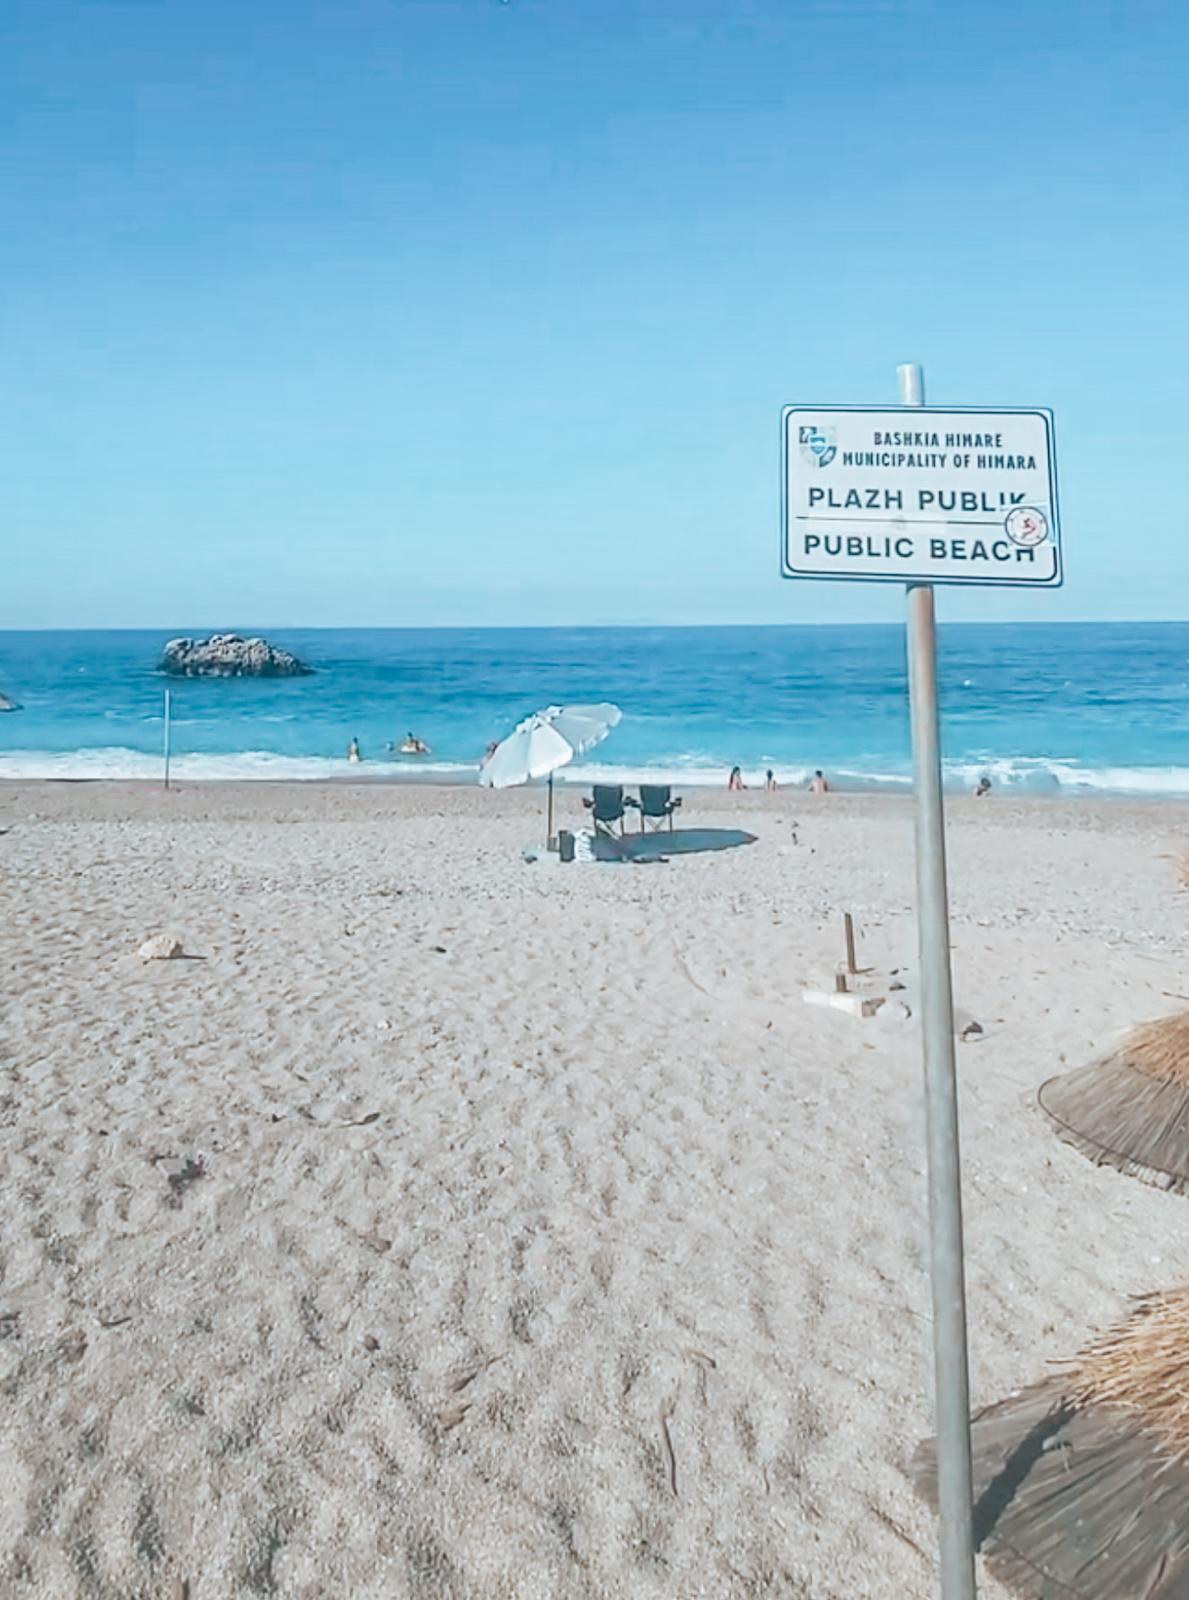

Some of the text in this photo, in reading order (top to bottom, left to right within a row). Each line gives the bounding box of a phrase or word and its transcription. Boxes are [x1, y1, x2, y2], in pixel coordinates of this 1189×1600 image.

[874, 432, 939, 446] BASHKIA
[843, 452, 1036, 469] MUNICIPALITY OF HIMARA
[809, 487, 902, 509] PLAZH
[804, 534, 1035, 562] PUBLIC BEACH
